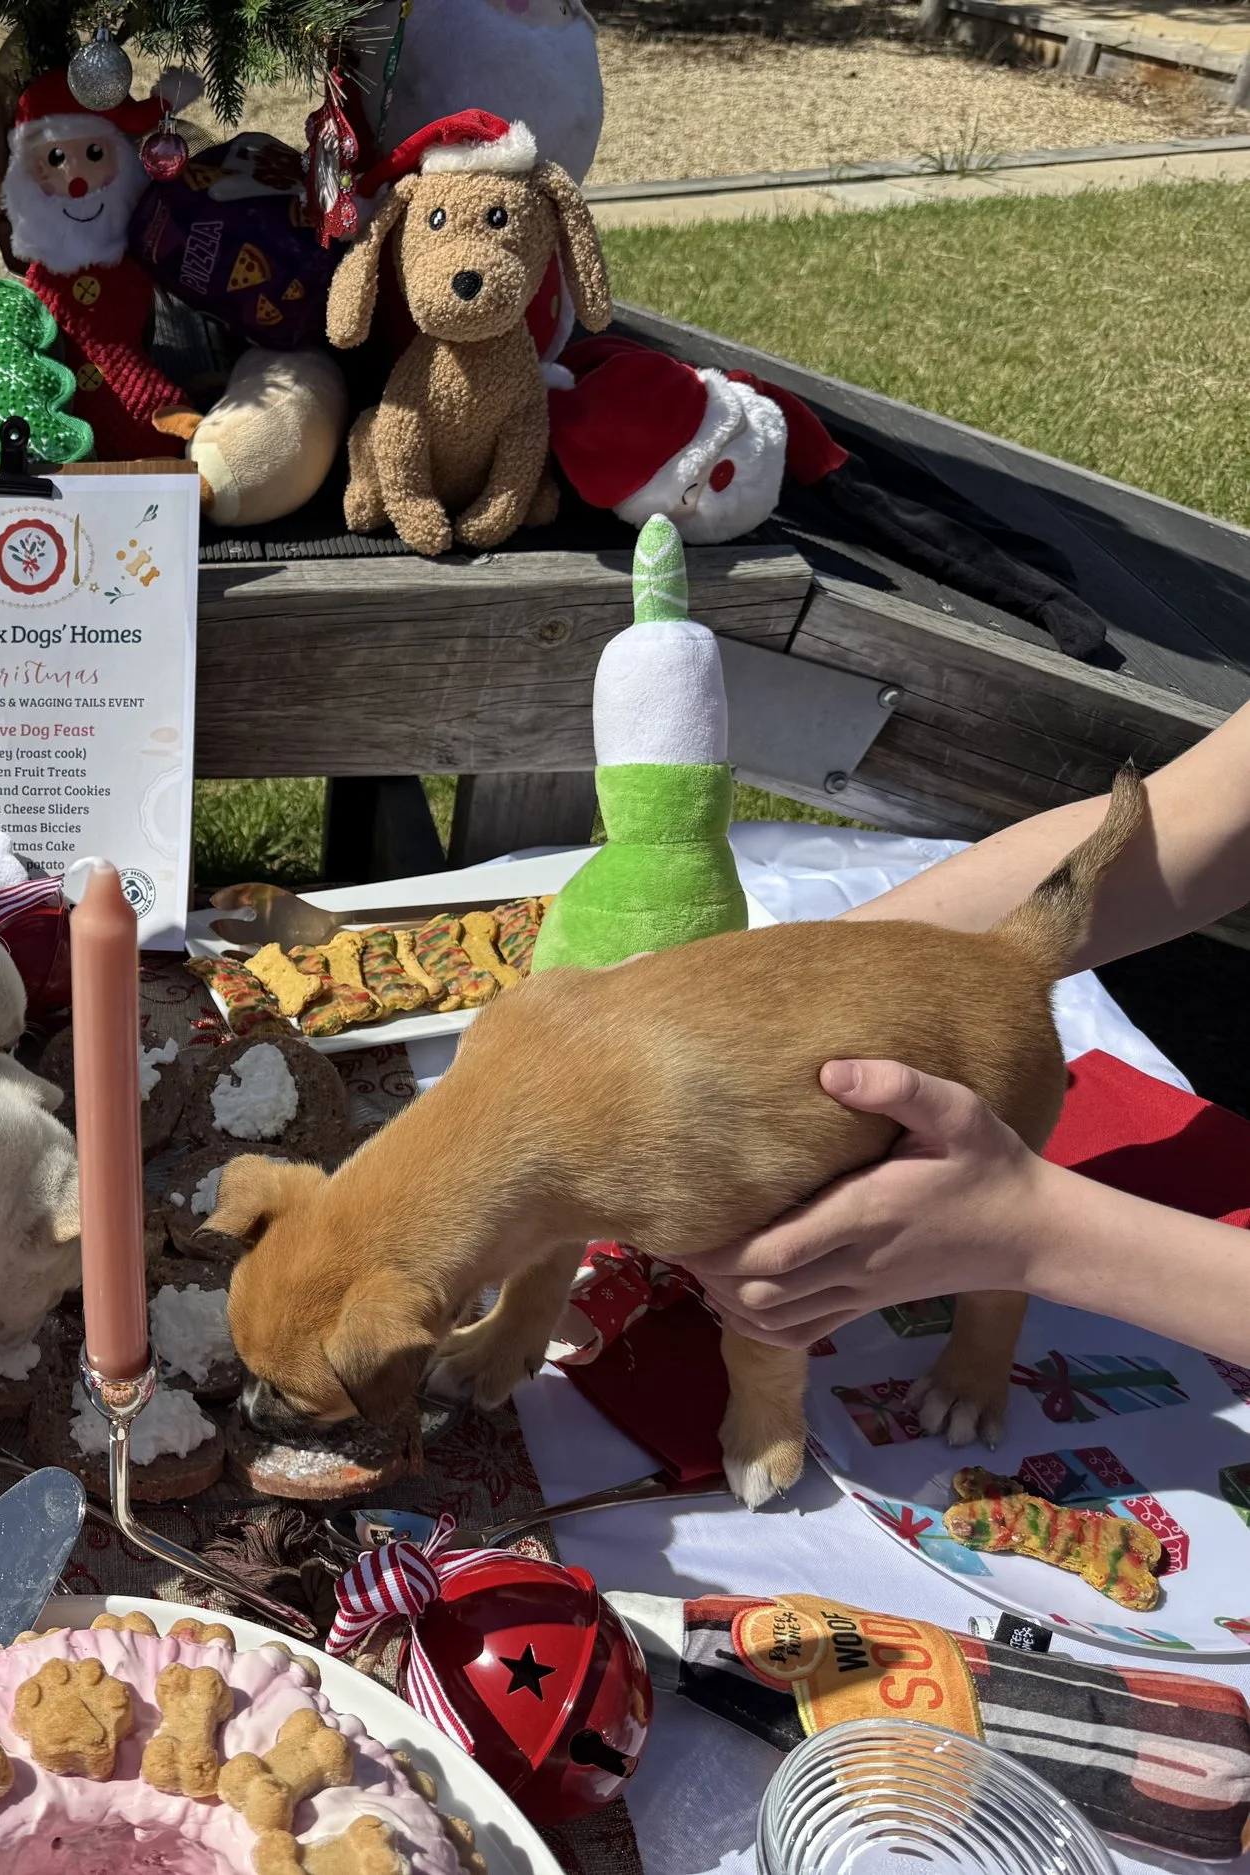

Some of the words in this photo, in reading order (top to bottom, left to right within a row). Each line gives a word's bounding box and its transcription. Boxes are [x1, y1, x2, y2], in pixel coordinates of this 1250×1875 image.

[180, 221, 223, 294] PIZZA
[70, 625, 142, 643] Homes
[8, 698, 17, 708] &
[19, 698, 72, 708] WAGGING
[75, 698, 106, 708] TAILS
[108, 698, 145, 708] EVENT
[20, 724, 50, 740] Dog
[53, 724, 95, 737] Feast
[16, 748, 52, 761] (roast
[54, 748, 87, 761] cook)
[14, 766, 44, 777] Fruit
[47, 766, 87, 777] Treats
[21, 785, 61, 796] Carrot
[64, 785, 111, 796] Cookies
[3, 804, 45, 815] Cheese
[48, 804, 90, 815] Sliders
[40, 822, 81, 833] Biccies
[45, 841, 75, 852] Cake
[26, 861, 65, 872] potato
[769, 1613, 787, 1664] BAXTER
[820, 1610, 870, 1673] WOOF
[859, 1614, 945, 1710] SOD
